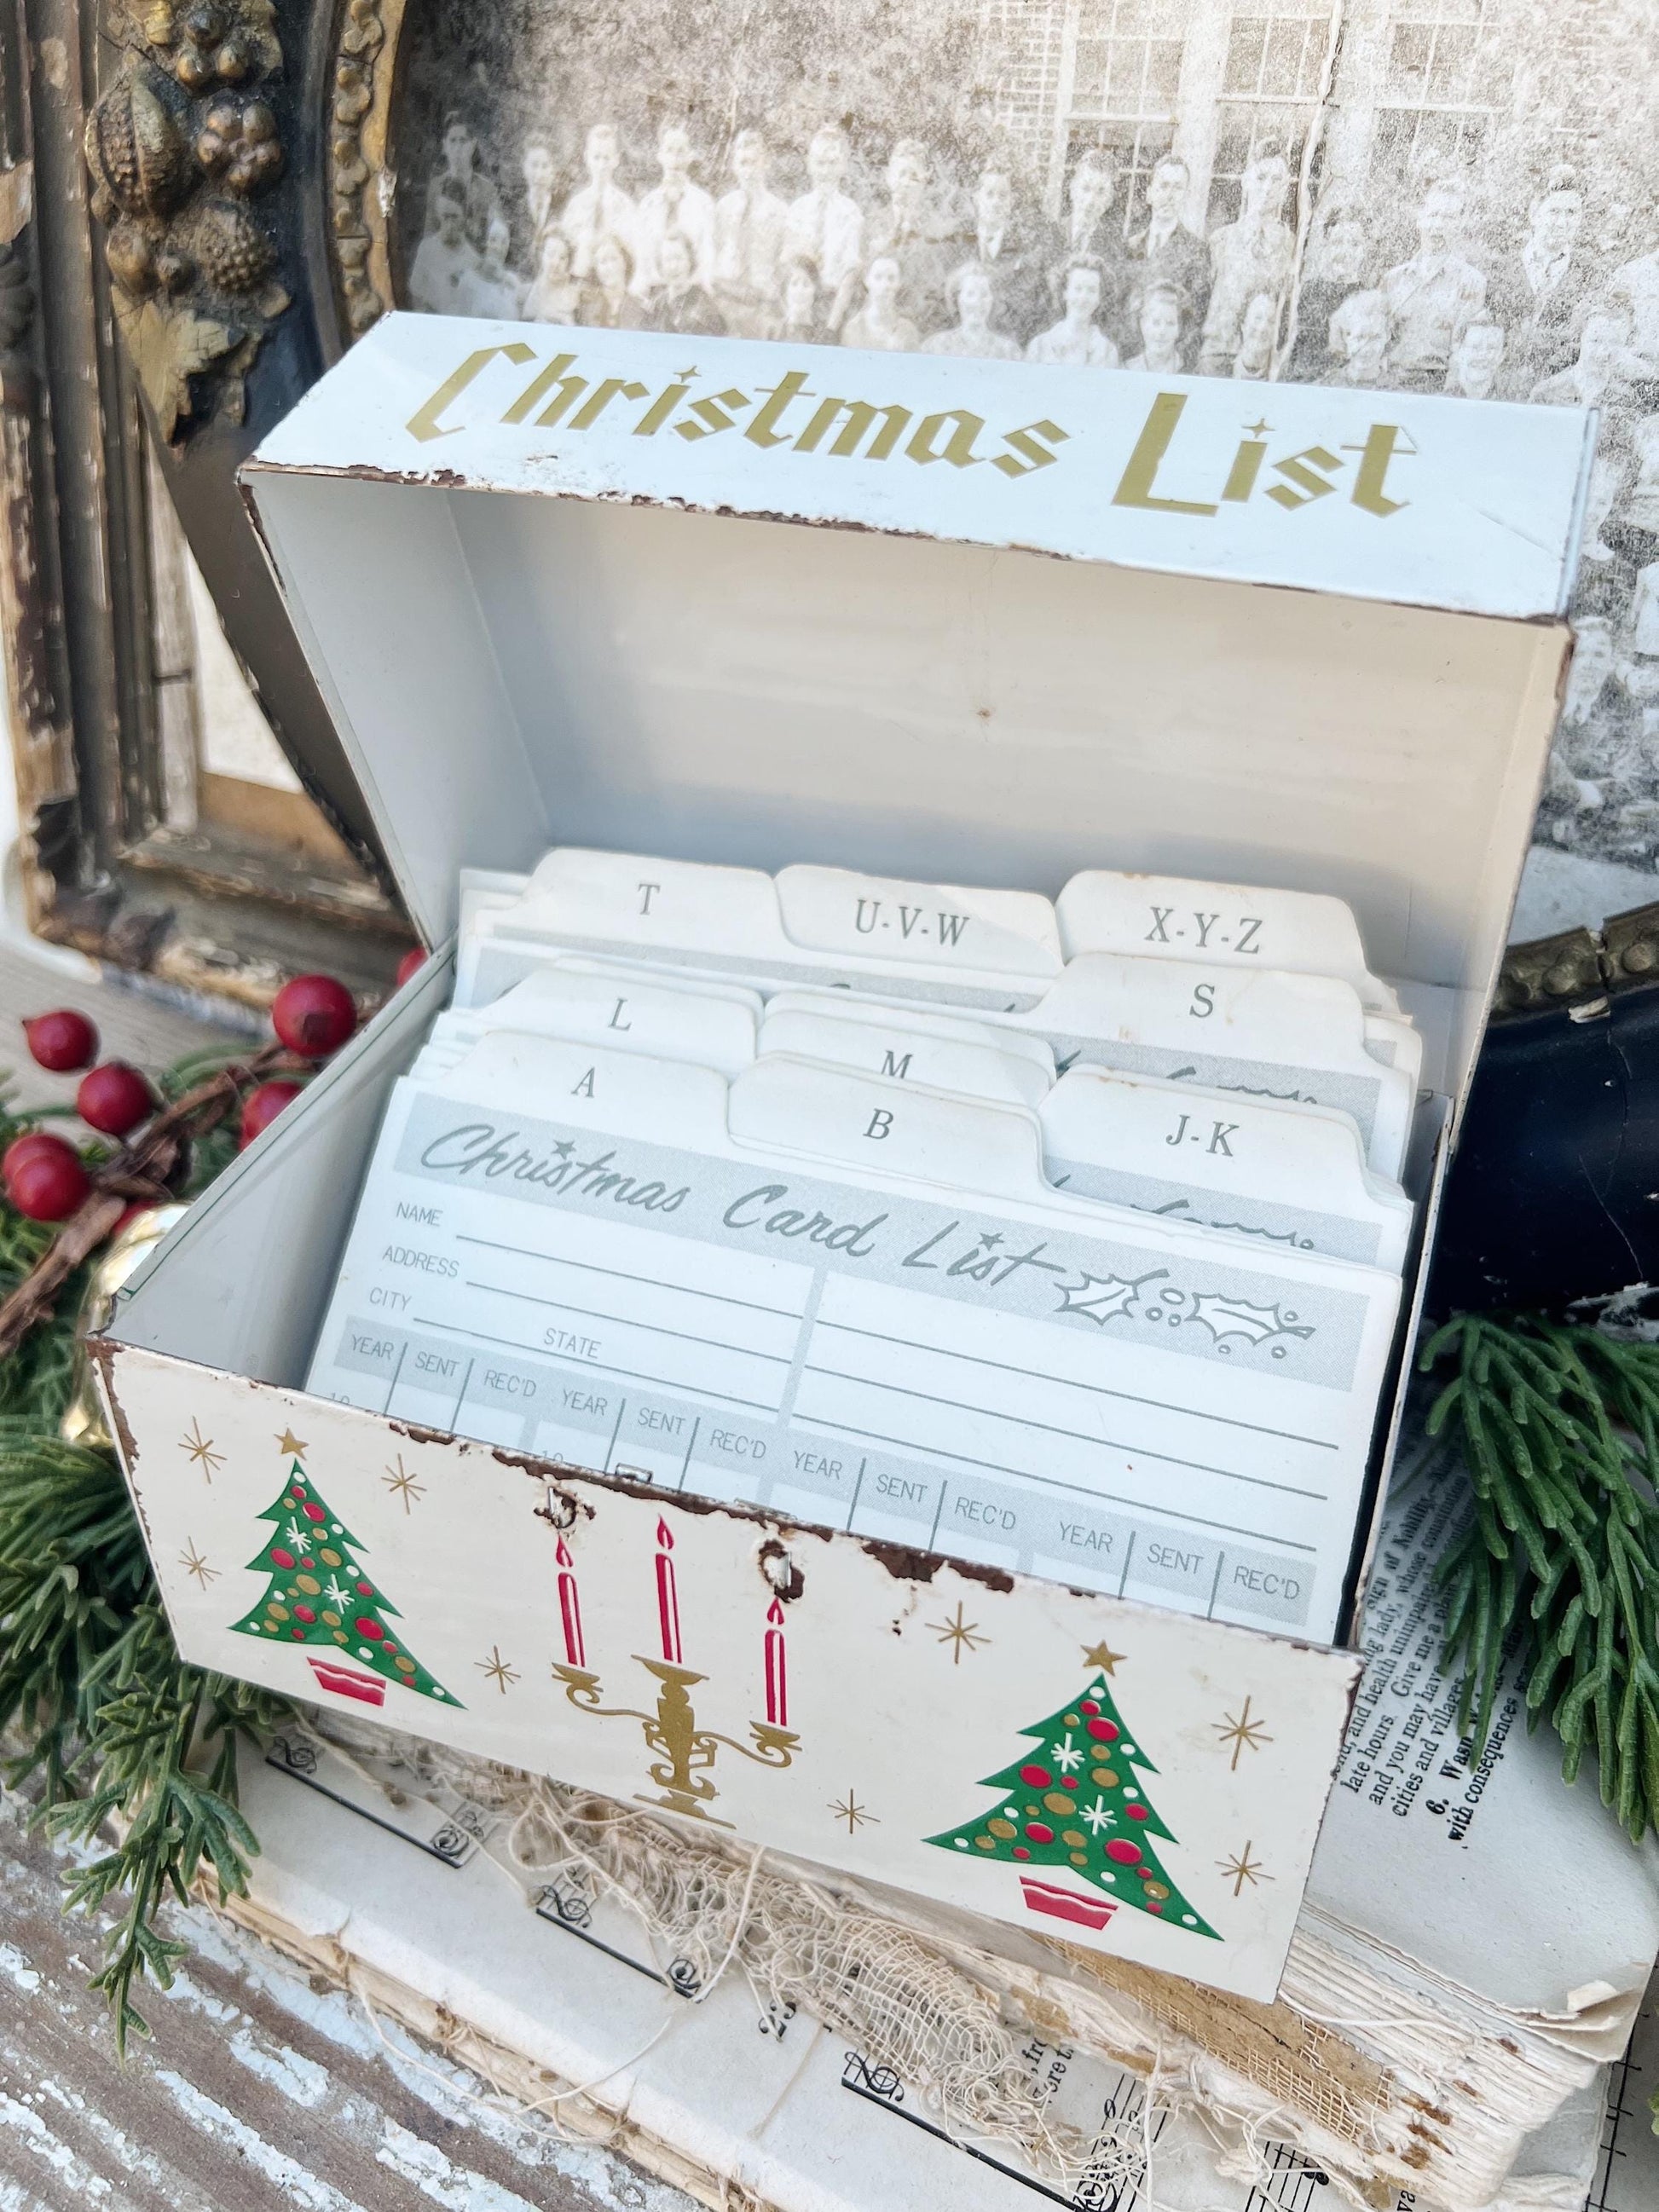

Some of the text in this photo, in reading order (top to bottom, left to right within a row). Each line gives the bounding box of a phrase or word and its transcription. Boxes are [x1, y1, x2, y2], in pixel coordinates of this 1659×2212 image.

[405, 341, 1416, 518] Christmas List
[638, 884, 660, 915] T
[608, 998, 632, 1031] L
[1190, 984, 1215, 1017] S
[571, 1067, 595, 1098] A
[882, 1050, 912, 1079] M
[863, 1109, 894, 1140] B
[1166, 1115, 1239, 1157] J-K
[396, 1201, 442, 1227] NAME
[421, 1125, 1066, 1285] Christmas Card List
[382, 1245, 460, 1278] ADDRESS
[369, 1287, 602, 1359] CITY STATE
[350, 1335, 1300, 1600] YEAR SENT REC'D YEAR SENT REC'D YEAR SENT REC'D YEAR SENT REC'D
[1340, 1762, 1371, 1793] late
[1390, 1660, 1419, 1699] Give
[1414, 1635, 1435, 1660] me
[1427, 1623, 1442, 1634] a
[1349, 1708, 1371, 1738] and
[1366, 1660, 1391, 1707] health
[1368, 1770, 1394, 1806] and
[1386, 1741, 1411, 1775] you
[1402, 1702, 1431, 1742] may
[1447, 1806, 1474, 1841] with
[1464, 1701, 1517, 1804] consequences
[1391, 1773, 1424, 1817] cities
[1415, 1737, 1439, 1772] and
[1425, 1799, 1450, 1816] 6.
